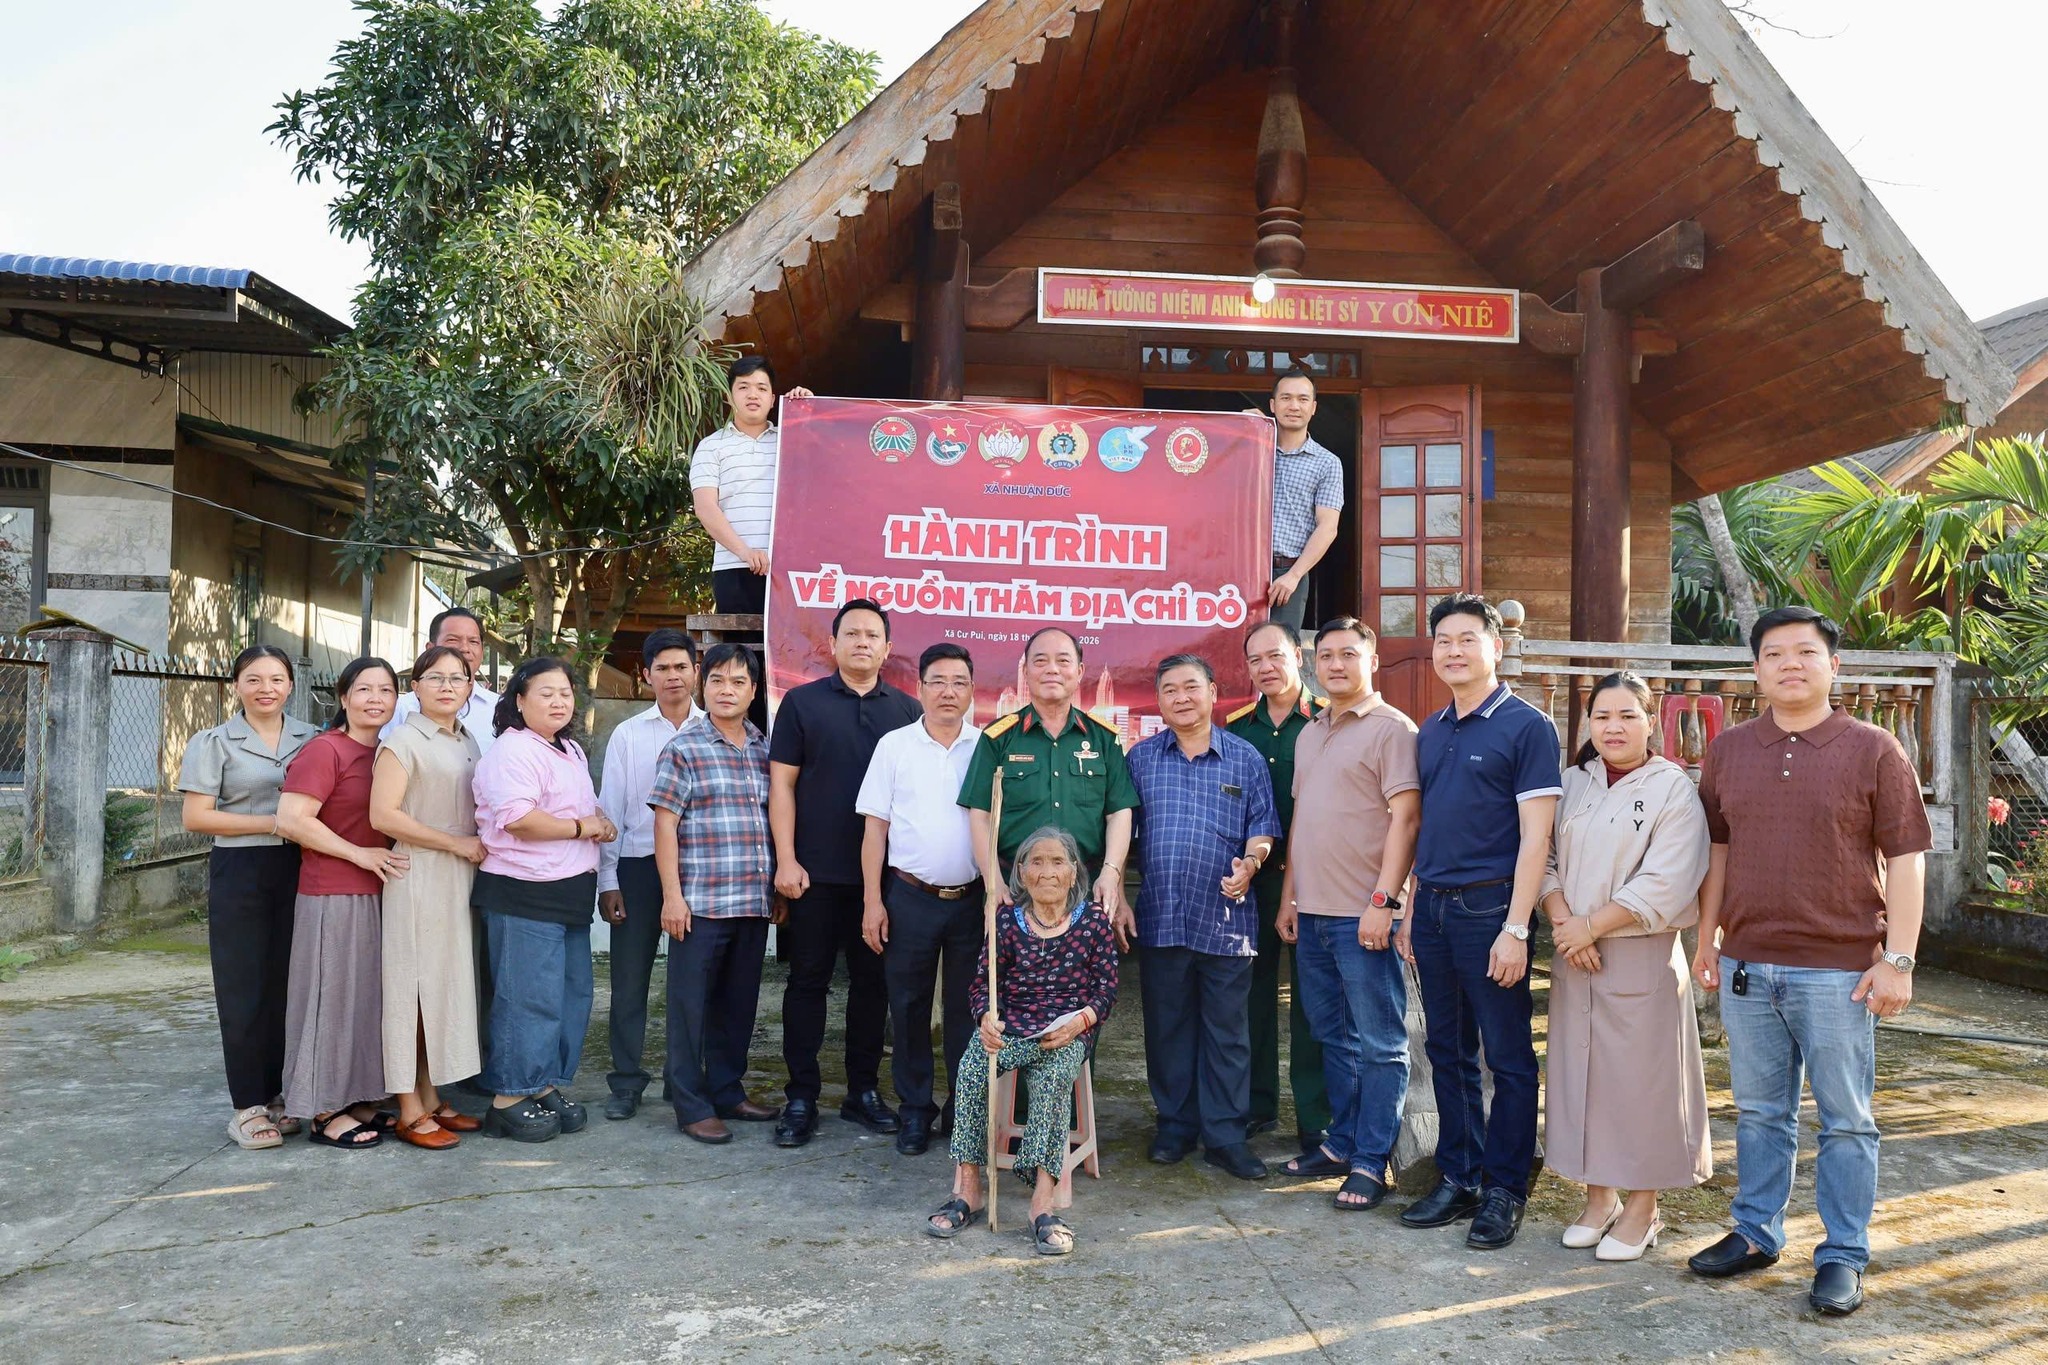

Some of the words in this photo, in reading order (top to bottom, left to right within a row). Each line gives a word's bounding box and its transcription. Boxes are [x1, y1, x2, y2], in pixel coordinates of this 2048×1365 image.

[1064, 284, 1098, 311] NHÀ
[1104, 284, 1157, 314] TƯỞNG
[1162, 289, 1206, 319] NIỆM
[1211, 295, 1246, 318] ANH
[1300, 295, 1334, 326] LIỆT
[1366, 301, 1386, 323] Y
[1392, 298, 1435, 326] ƠN
[1441, 300, 1493, 328] NIÊ
[984, 480, 1001, 494] XÃ
[1002, 483, 1044, 498] NHUẬN
[1046, 484, 1071, 497] ĐỨC
[888, 511, 1019, 561] HÀNH
[1029, 516, 1163, 567] TRÌNH
[794, 567, 839, 604] VỀ
[843, 573, 966, 611] NGUỒN
[972, 582, 1063, 617] THĂM
[1068, 591, 1127, 625] ĐỊA
[1132, 586, 1189, 622] CHỈ
[1195, 588, 1243, 624] ĐỎ
[944, 629, 955, 638] Xã
[957, 630, 968, 639] Cư
[970, 630, 986, 641] Pui,
[988, 632, 1008, 642] ngày
[1010, 633, 1019, 641] 18
[1079, 636, 1100, 645] 2026
